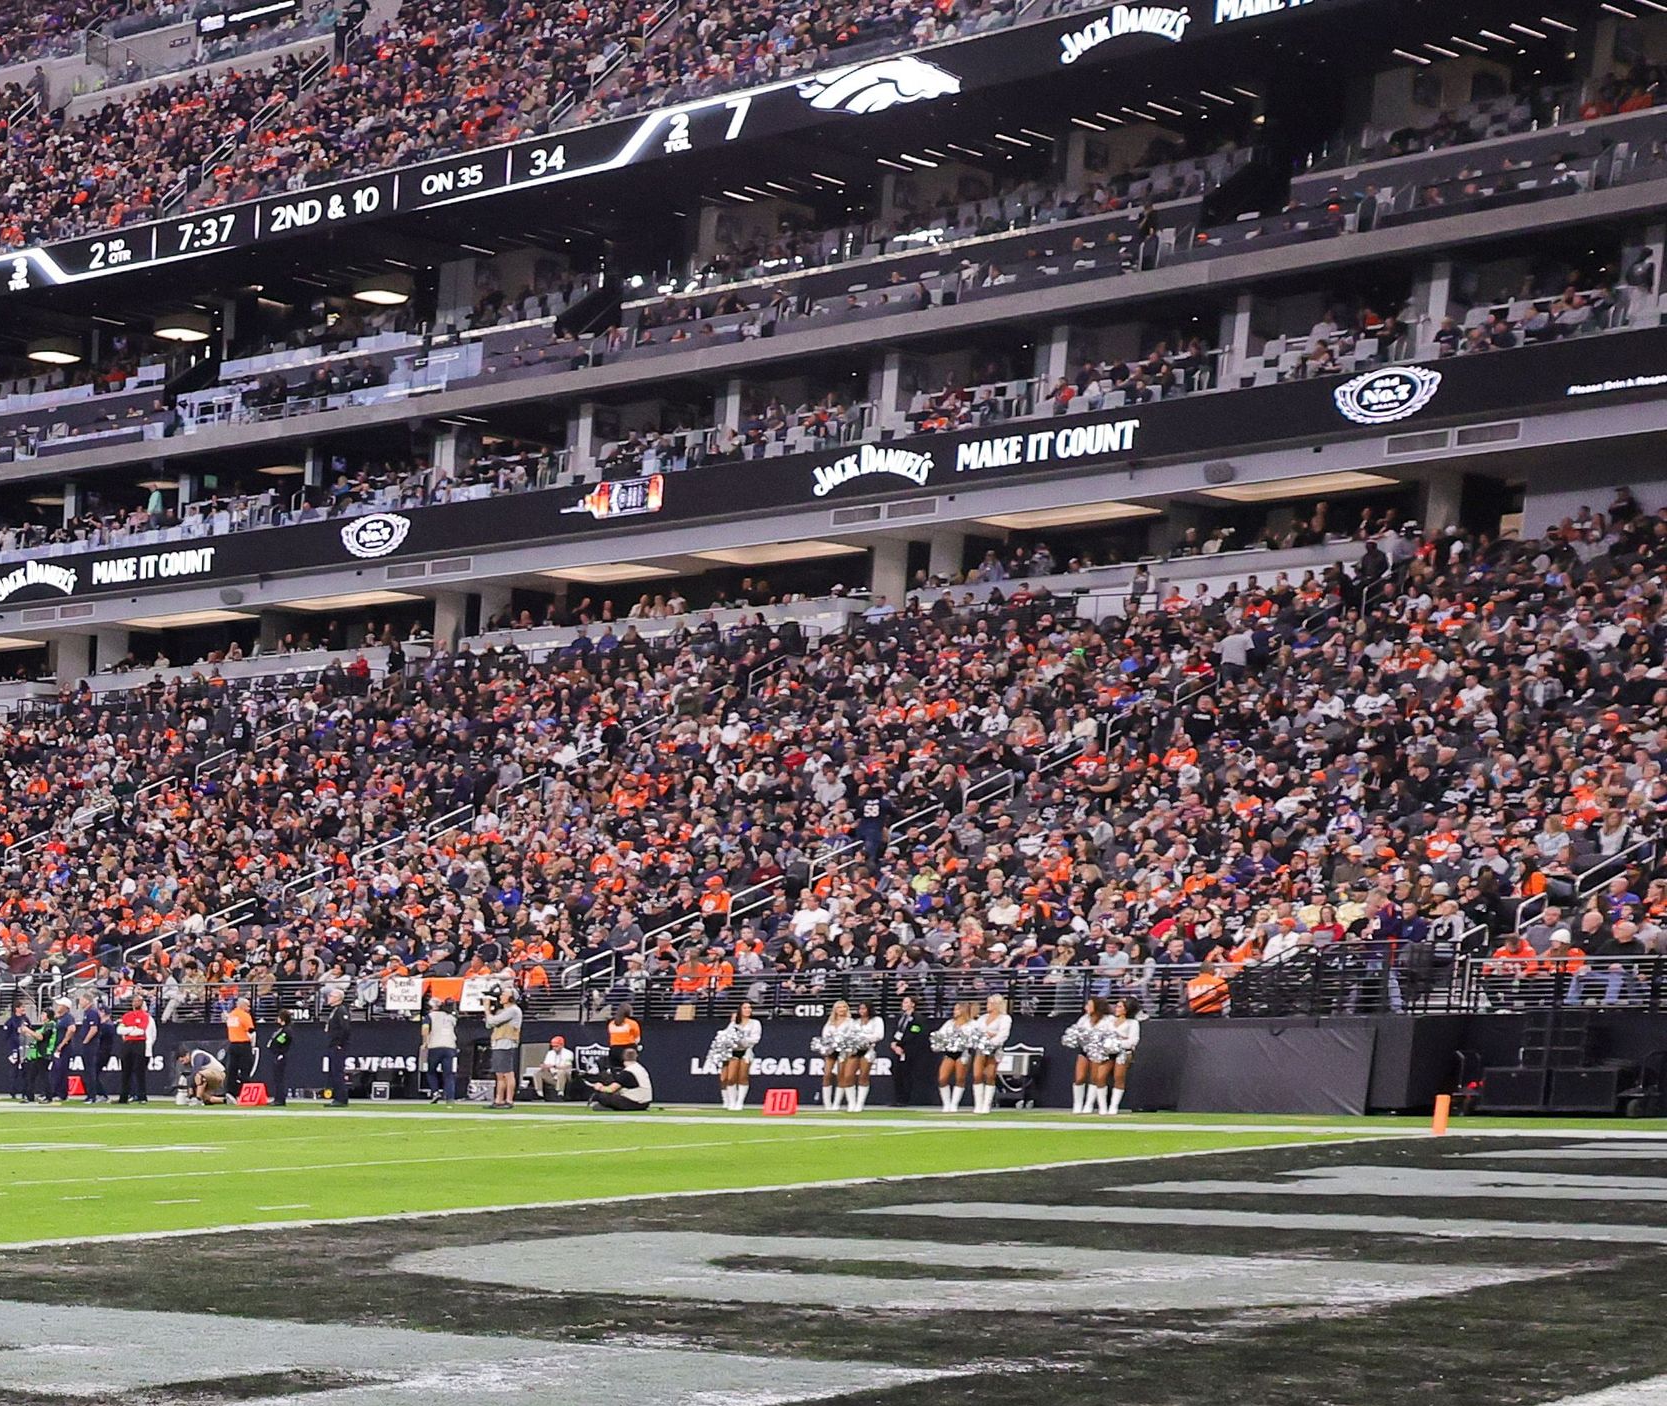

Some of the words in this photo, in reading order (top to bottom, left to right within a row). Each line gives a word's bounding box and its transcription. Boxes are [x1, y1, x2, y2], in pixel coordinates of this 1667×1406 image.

[1061, 16, 1112, 64] JACK
[1111, 5, 1191, 42] DANIEL'S
[668, 114, 688, 139] 2
[724, 100, 751, 140] 7
[271, 200, 323, 232] 2ND
[328, 195, 347, 220] &
[354, 187, 380, 213] 10
[421, 172, 454, 195] ON
[453, 164, 484, 188] 35
[529, 145, 565, 176] 34
[178, 214, 235, 251] 7:37
[90, 242, 105, 269] 2
[108, 250, 132, 264] QTR
[109, 239, 125, 252] ND
[12, 258, 28, 280] 3
[812, 452, 861, 497] JACK
[860, 444, 935, 487] DANIEL'S
[956, 435, 1024, 472] MAKE
[1026, 431, 1055, 464] IT
[1056, 419, 1140, 459] COUNT
[26, 558, 78, 595] DANIEL'S
[92, 556, 138, 586] MAKE
[138, 553, 159, 581] IT
[158, 547, 215, 577] COUNT
[795, 1005, 824, 1017] C115
[749, 1058, 805, 1075] EGAS
[241, 1086, 259, 1103] 20
[771, 1092, 789, 1112] 10
